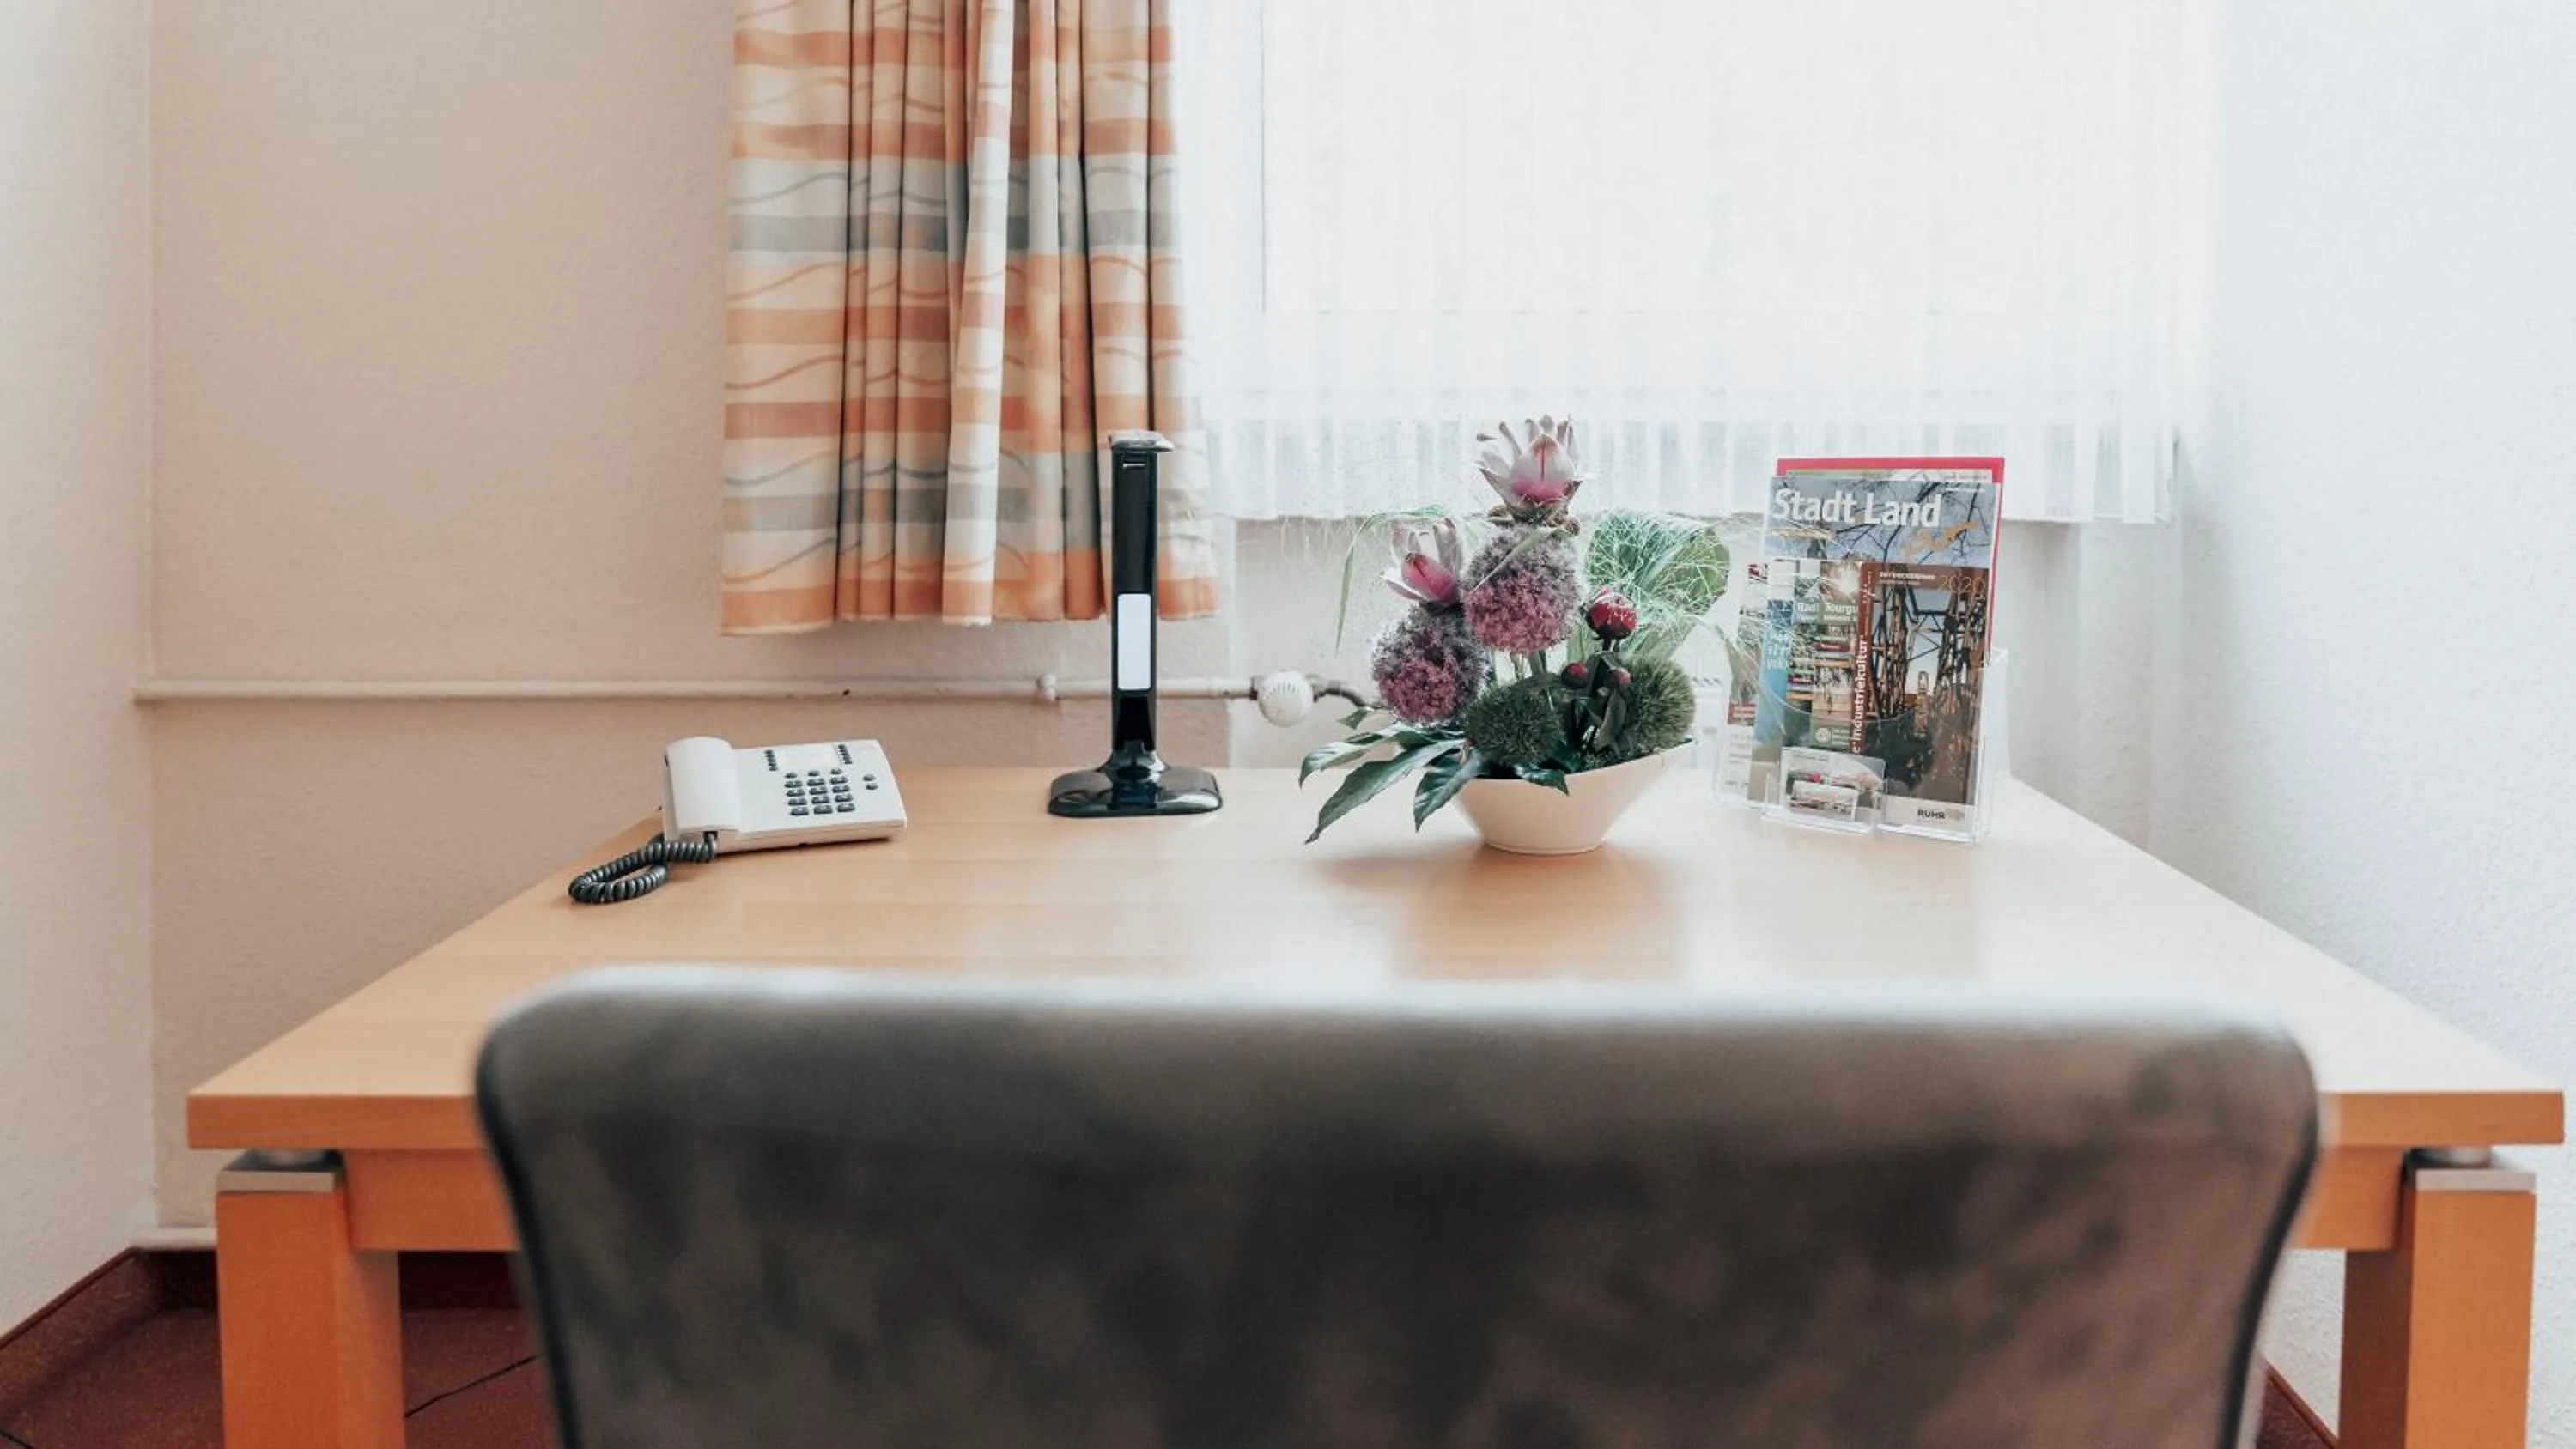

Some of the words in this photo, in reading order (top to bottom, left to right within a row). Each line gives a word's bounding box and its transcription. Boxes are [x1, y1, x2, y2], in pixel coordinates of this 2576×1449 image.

[1774, 488, 1857, 523] Stadt
[1864, 492, 1942, 528] Land
[1917, 809, 1946, 819] RUHR
